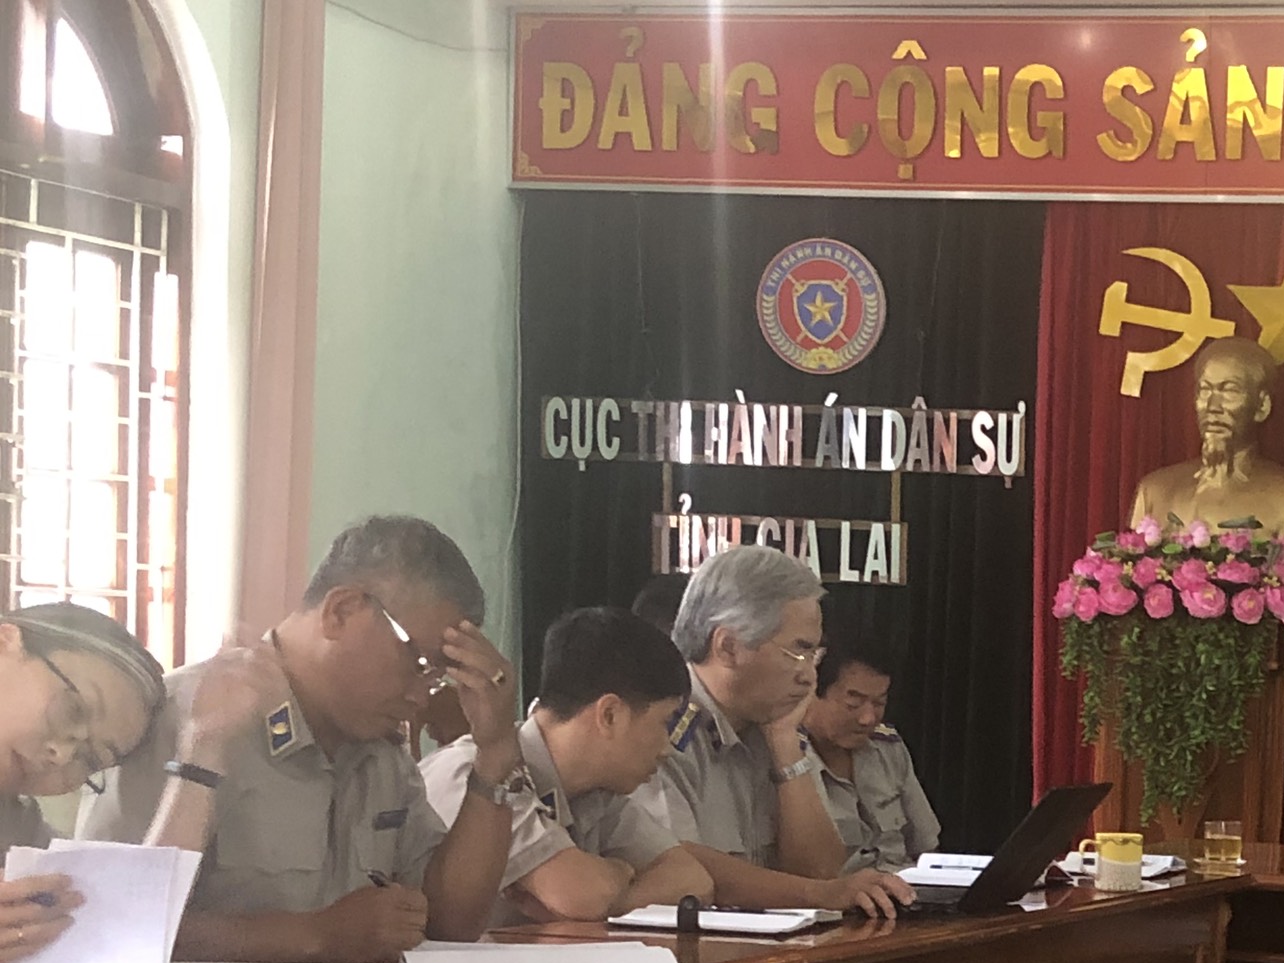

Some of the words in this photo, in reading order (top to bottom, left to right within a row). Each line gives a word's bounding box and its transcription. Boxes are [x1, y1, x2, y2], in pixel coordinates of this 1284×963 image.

[539, 27, 779, 154] ĐẢNG
[814, 40, 1064, 179] CỘNG
[1097, 28, 1284, 161] SẢN
[545, 397, 620, 471] CỤC
[631, 400, 692, 464] THI
[704, 389, 802, 466] HÀNH
[815, 392, 866, 470] ÁN
[881, 396, 957, 473] DÂN
[971, 401, 1025, 488] SỰ
[653, 493, 741, 574] TỈNH
[840, 520, 901, 583] LAI
